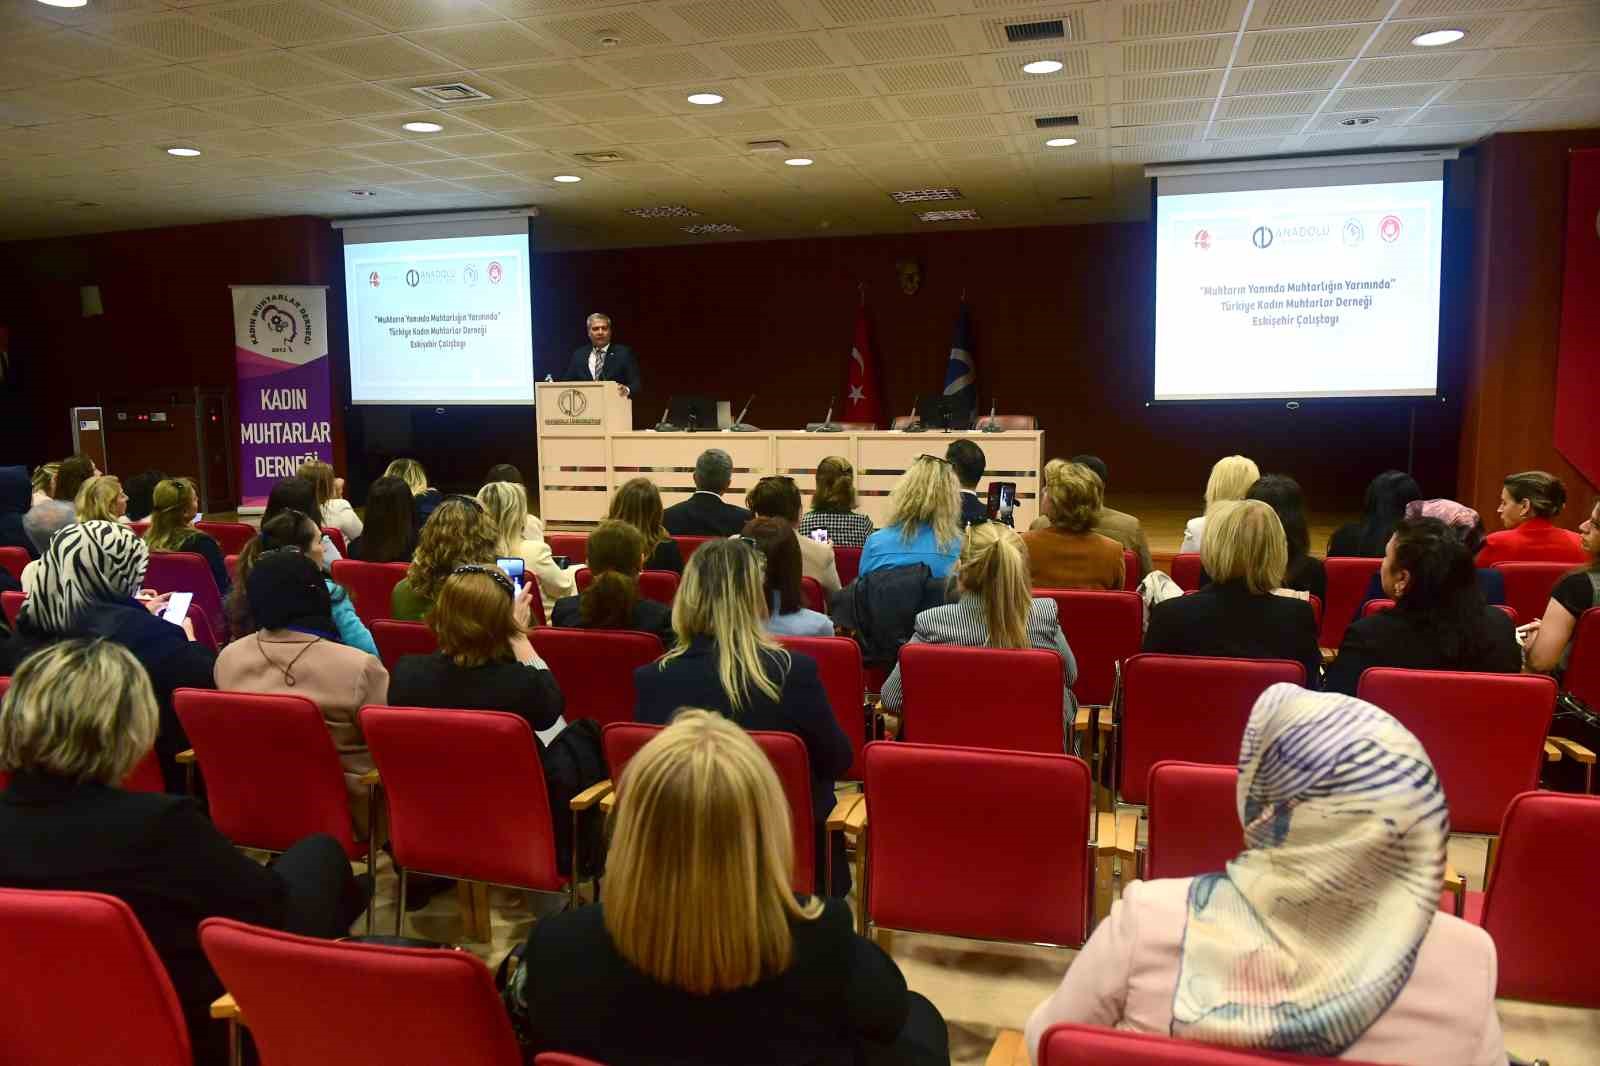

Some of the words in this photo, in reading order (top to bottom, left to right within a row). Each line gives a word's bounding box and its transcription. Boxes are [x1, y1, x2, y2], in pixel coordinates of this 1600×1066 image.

[1248, 284, 1286, 295] Yanında
[1287, 281, 1343, 295] Muhtarlığın
[1221, 301, 1256, 314] Türkiye
[1257, 299, 1284, 310] Kadın
[1286, 298, 1334, 309] Muhtarlar
[1335, 295, 1373, 310] Derneği
[1252, 315, 1295, 328] Eskişehir
[1296, 313, 1340, 328] Çalıştayı
[430, 326, 462, 336] Muhtarlar
[462, 325, 488, 337] Derneği
[260, 388, 308, 411] KADIN
[240, 421, 332, 445] MUHTARLAR
